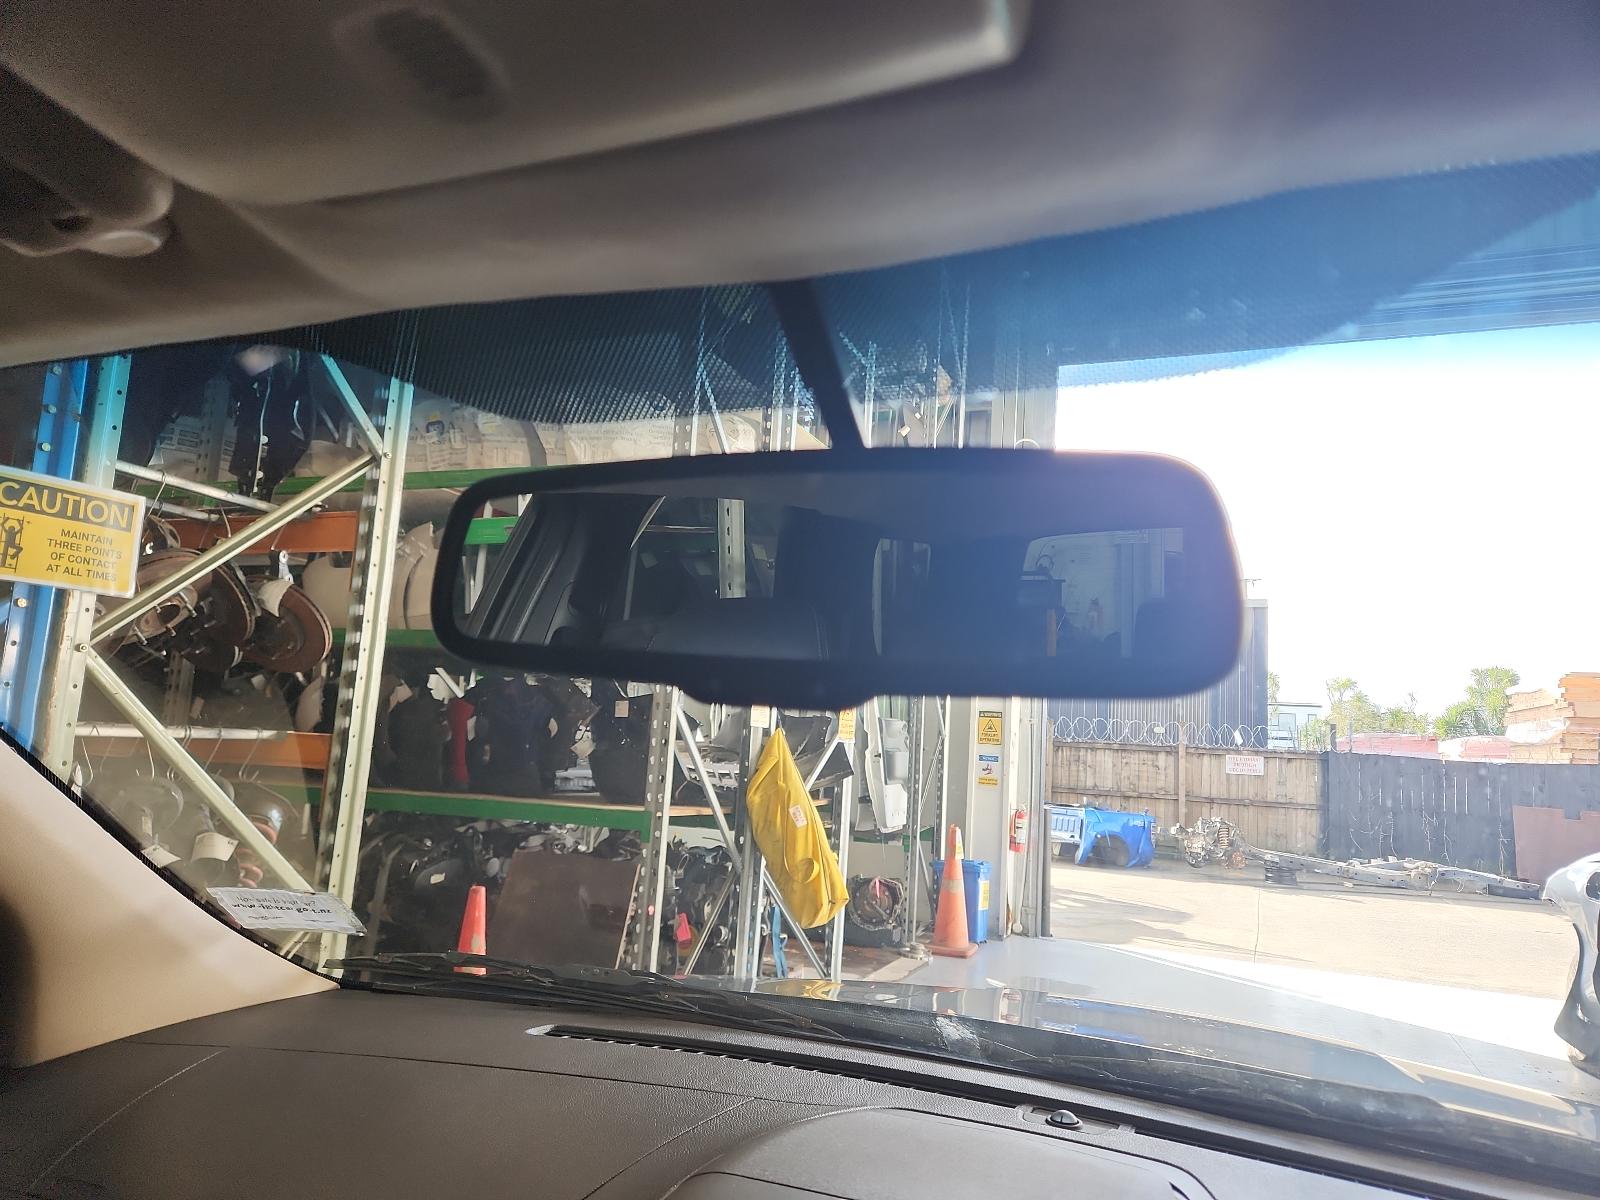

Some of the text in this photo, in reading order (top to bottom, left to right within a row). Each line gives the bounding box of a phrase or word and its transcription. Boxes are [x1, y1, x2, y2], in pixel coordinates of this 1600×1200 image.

[0, 481, 129, 528] CAUTION
[60, 528, 113, 545] MAINTAIN
[48, 538, 122, 560] THREE POINTS
[50, 551, 118, 569] OF CONTACT
[46, 564, 117, 581] AT ALL TIMES
